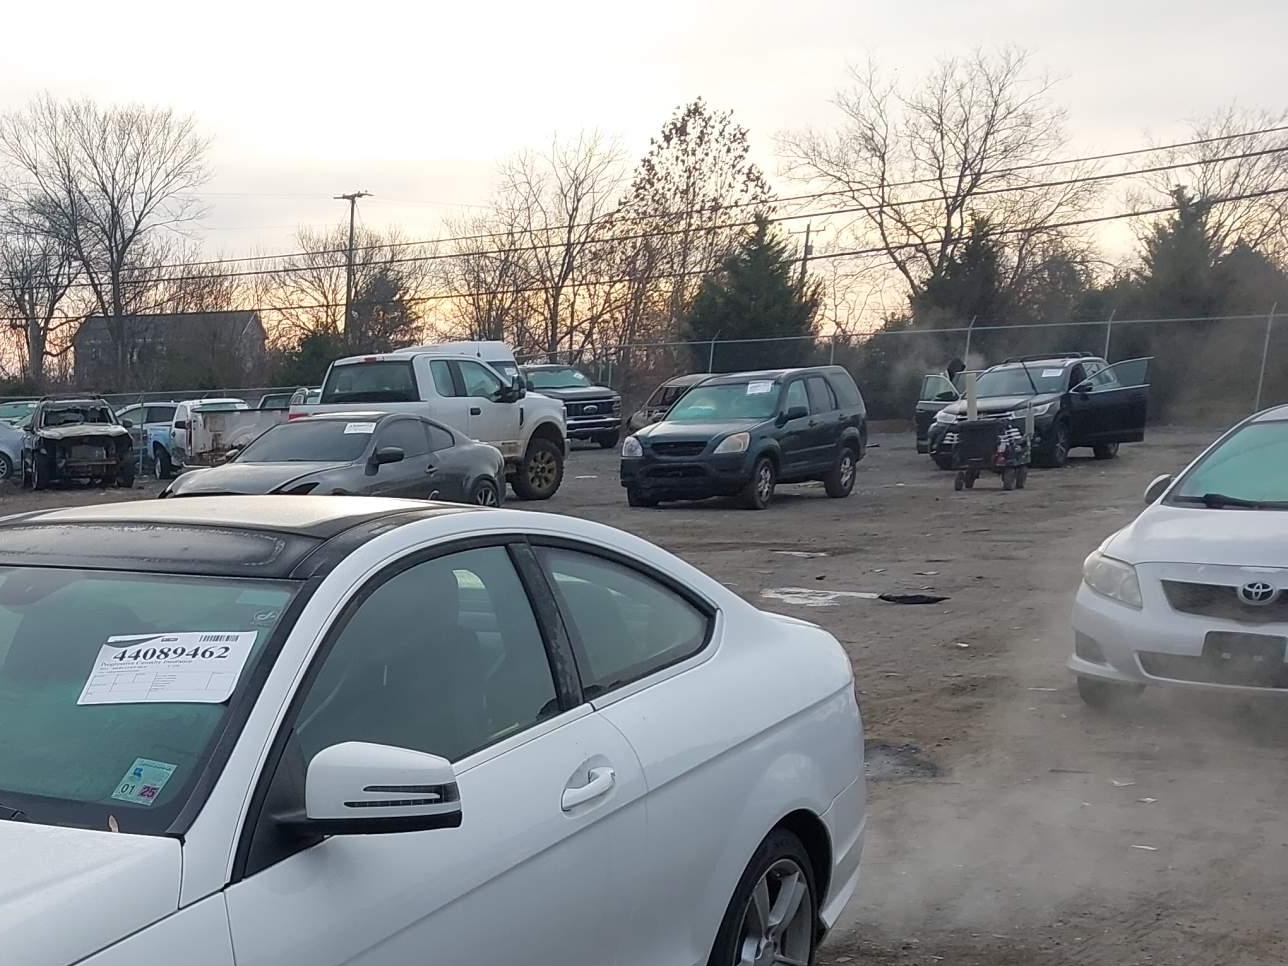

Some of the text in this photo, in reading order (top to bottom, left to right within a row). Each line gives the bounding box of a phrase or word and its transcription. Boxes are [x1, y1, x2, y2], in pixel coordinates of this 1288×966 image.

[113, 646, 231, 662] 44089462
[120, 784, 160, 798] 01 25
